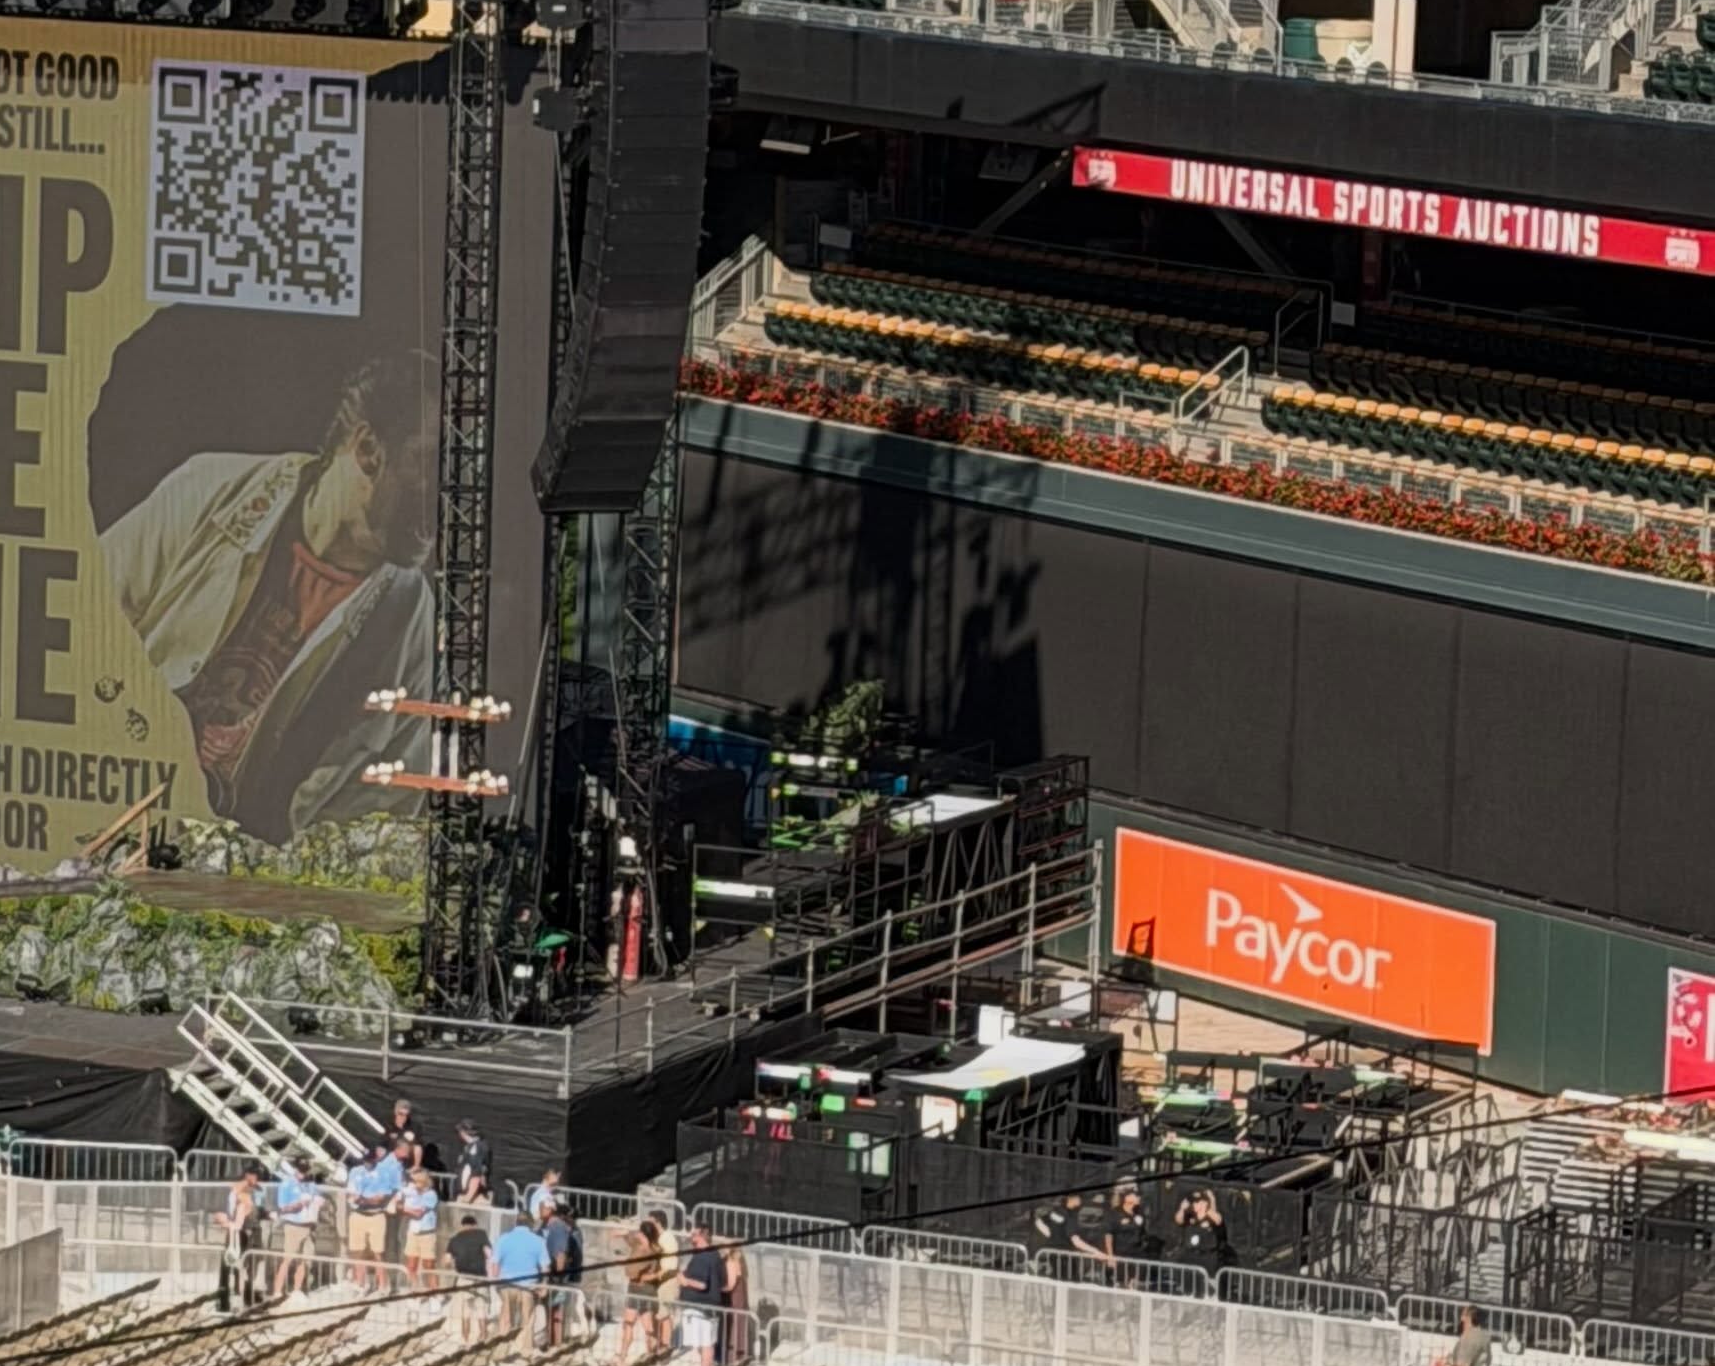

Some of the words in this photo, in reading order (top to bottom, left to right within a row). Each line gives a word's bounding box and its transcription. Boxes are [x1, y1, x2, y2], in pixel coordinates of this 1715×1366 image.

[35, 50, 120, 102] GOOD
[1170, 159, 1320, 218] UNIVERSAL
[1333, 180, 1441, 235] SPORTS
[1452, 197, 1601, 257] AUCTIONS
[20, 747, 178, 810] DIRECTLY
[1205, 887, 1393, 989] Paycor
